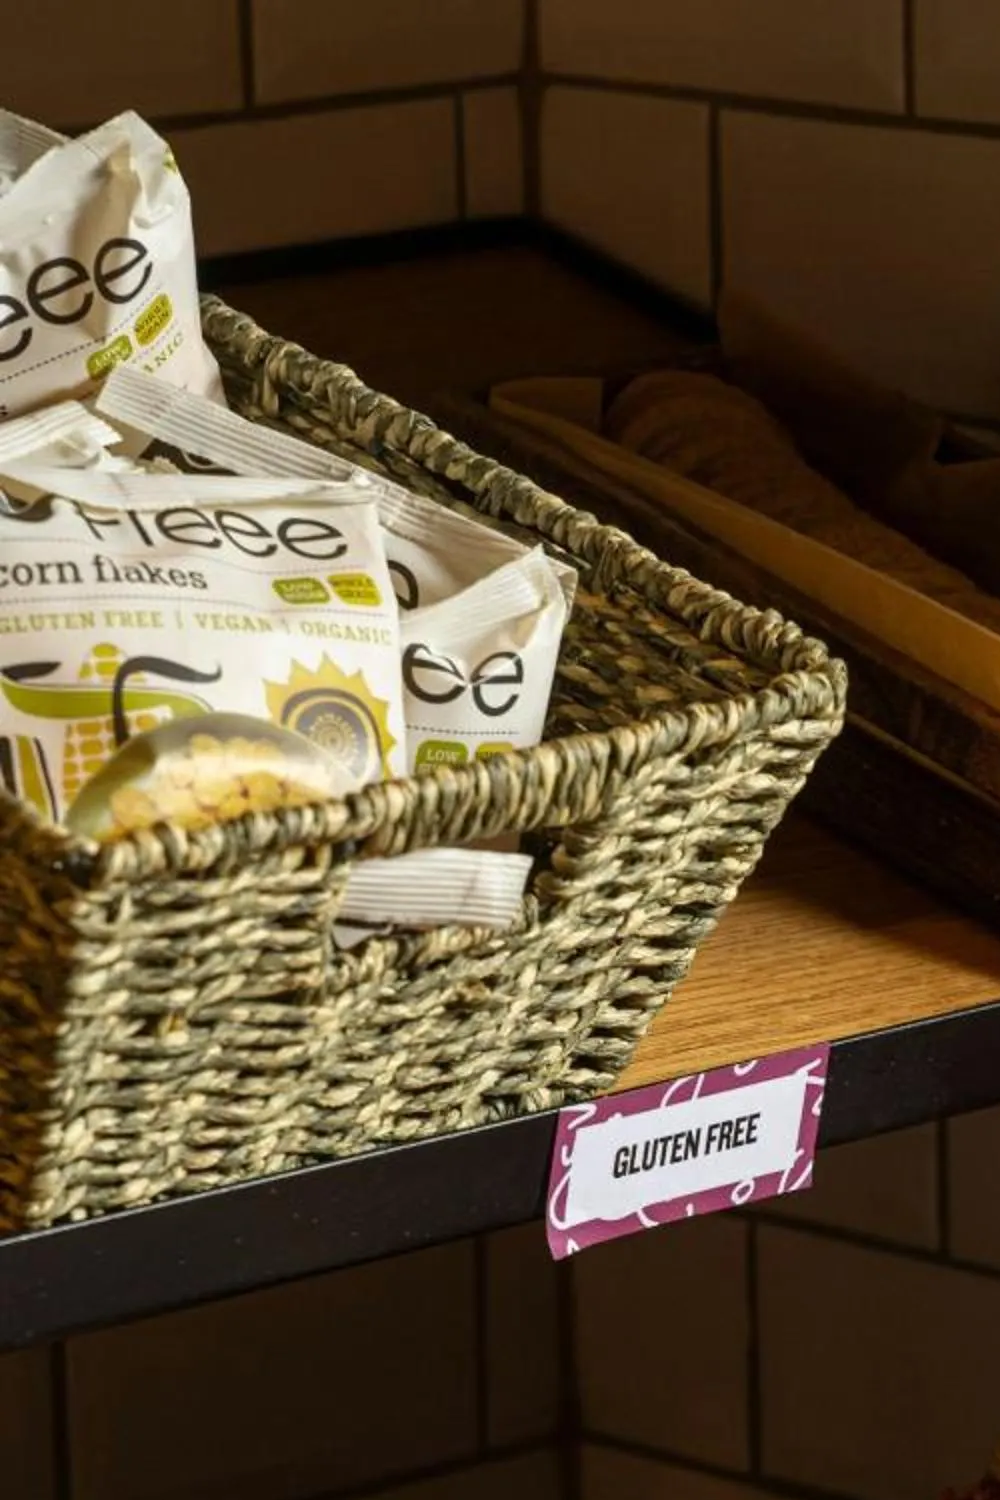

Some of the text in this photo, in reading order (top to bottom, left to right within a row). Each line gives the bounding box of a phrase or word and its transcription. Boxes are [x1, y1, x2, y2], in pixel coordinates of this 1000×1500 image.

[93, 554, 208, 590] flakes
[0, 610, 392, 646] GLUTEN FREE VEGAN ORGANIC
[426, 748, 460, 762] LOW
[612, 1111, 761, 1179] GLUTEN FREE
